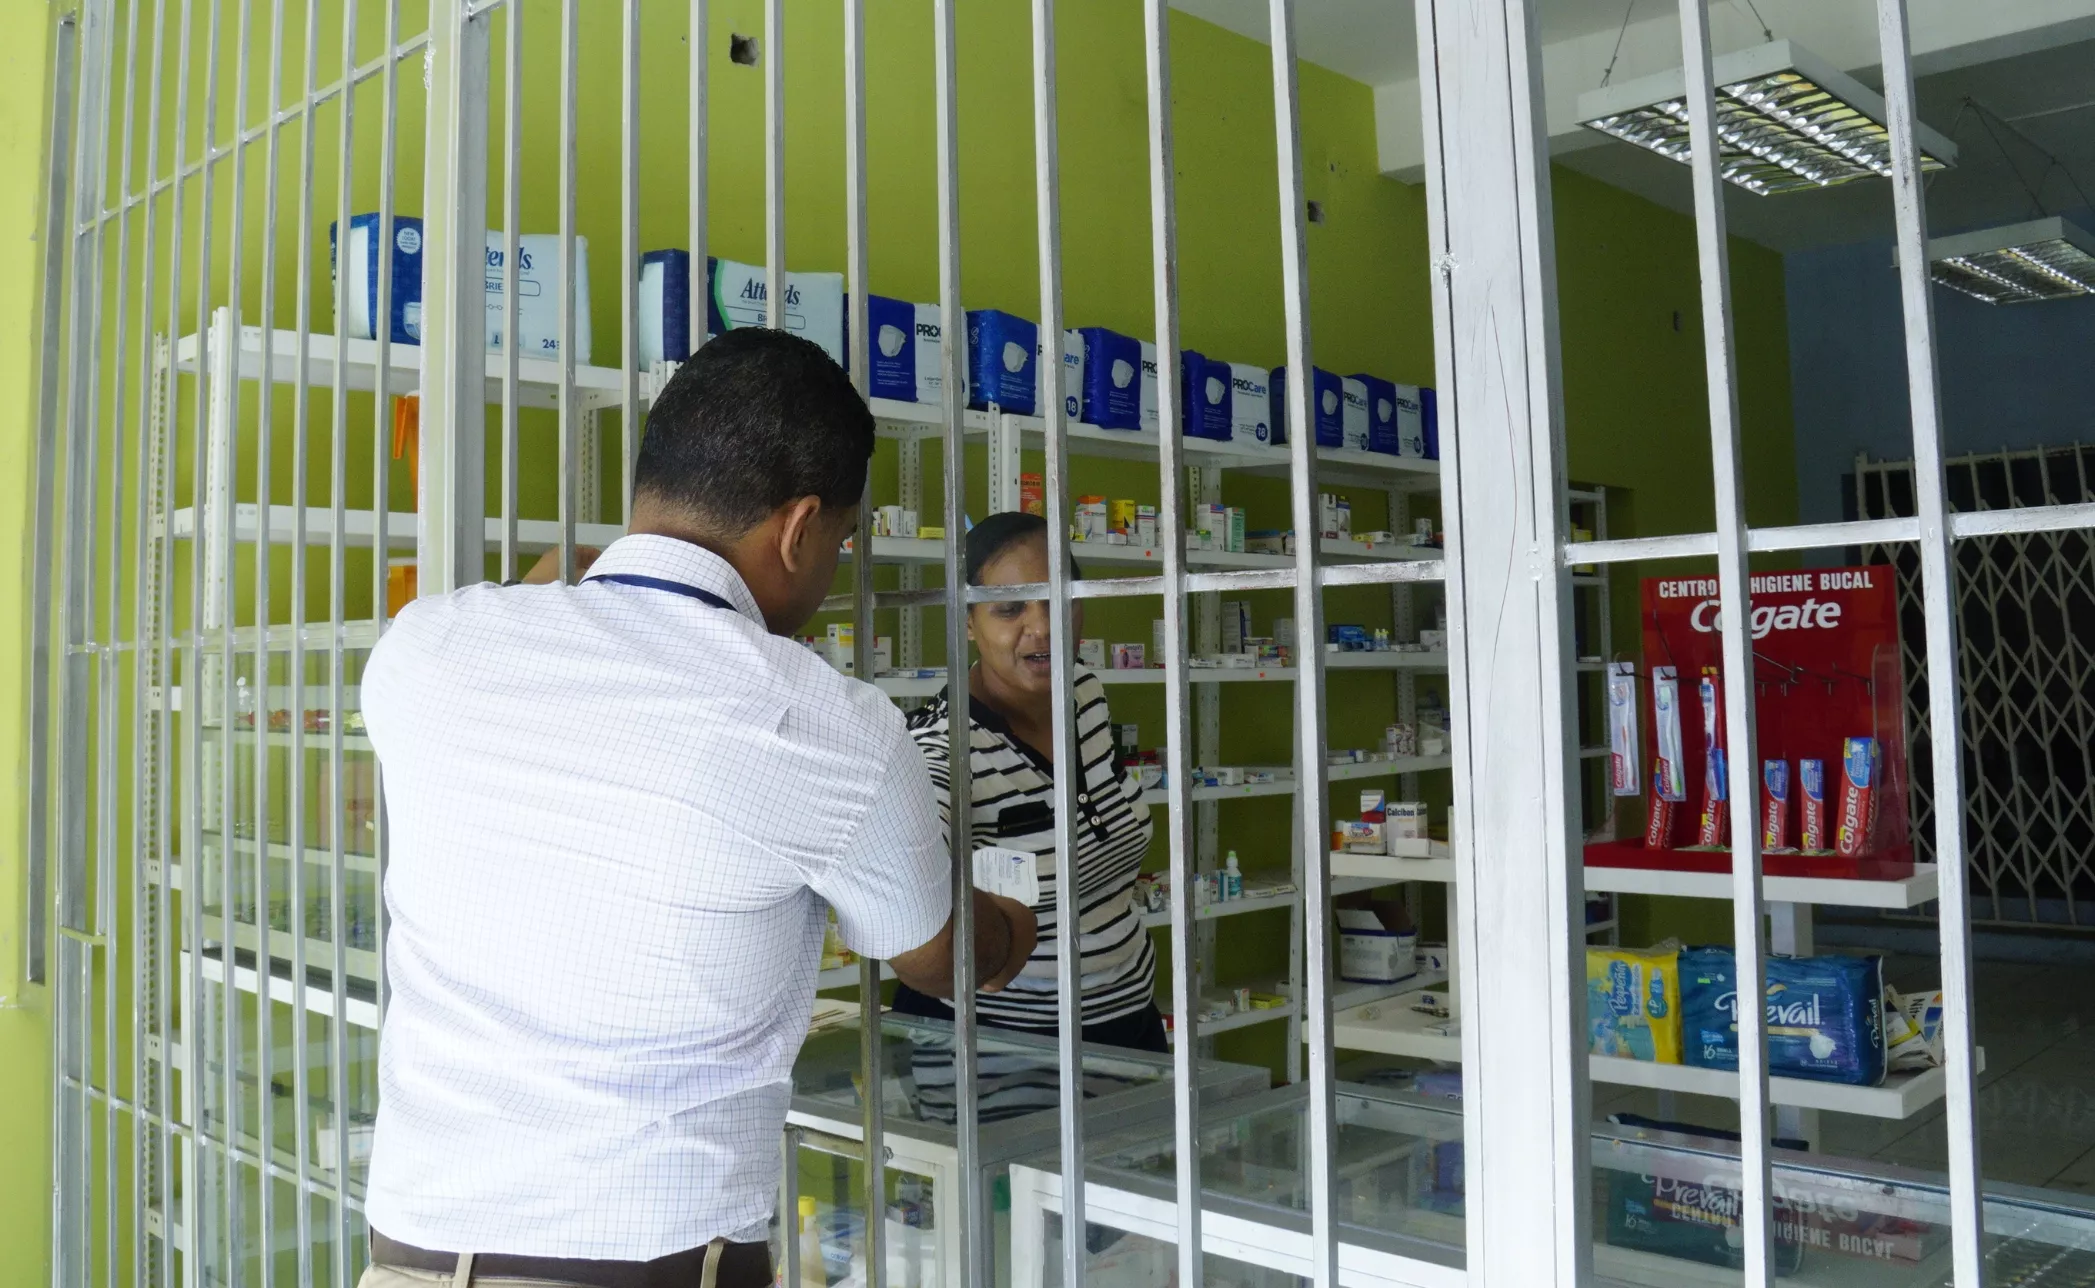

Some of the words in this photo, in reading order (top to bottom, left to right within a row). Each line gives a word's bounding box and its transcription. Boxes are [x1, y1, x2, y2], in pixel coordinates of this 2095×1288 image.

[1232, 377, 1267, 395] PROCare
[1066, 400, 1077, 412] 18
[1255, 429, 1266, 438] 18
[1659, 579, 1718, 598] CENTRO
[1750, 573, 1813, 594] HIGIENE
[1820, 571, 1873, 591] BUCAL
[1614, 757, 1622, 788] Colgate
[1387, 807, 1415, 817] Calcibon
[1648, 799, 1662, 847] Colgate
[1840, 786, 1859, 854] Colgate
[1806, 801, 1818, 849] olgate
[1703, 1044, 1716, 1060] 16
